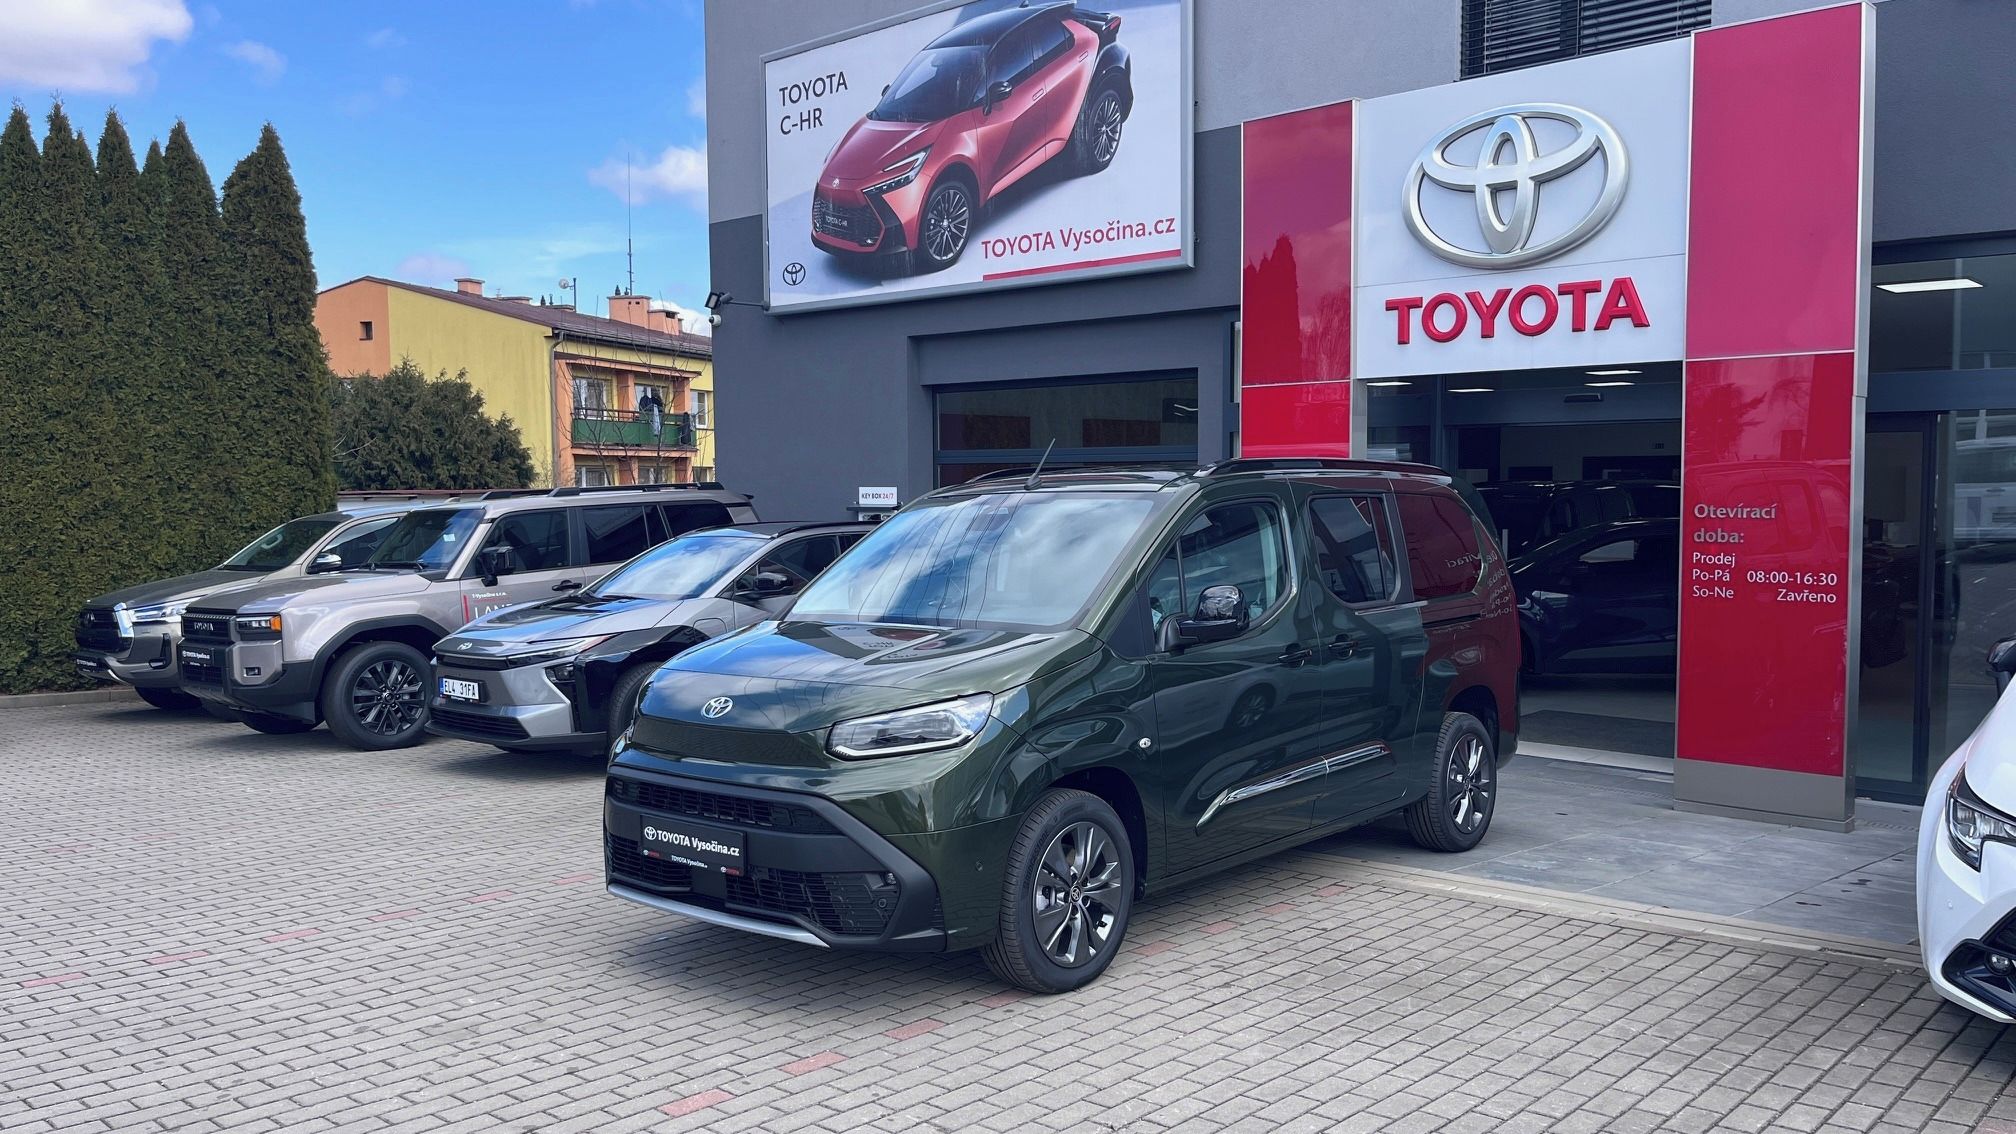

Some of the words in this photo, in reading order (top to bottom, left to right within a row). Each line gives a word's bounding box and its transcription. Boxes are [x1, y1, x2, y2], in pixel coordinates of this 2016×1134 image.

[778, 71, 848, 107] TOYOTA
[780, 107, 823, 135] C-HR
[981, 231, 1055, 259] TOYOTA
[1060, 217, 1176, 251] Vysočina.cz
[1385, 277, 1650, 345] TOYOTA
[861, 492, 871, 500] KEY
[871, 492, 882, 500] BOX
[1693, 503, 1778, 519] Otevírací
[1693, 527, 1745, 543] doba:
[1692, 552, 1736, 568] Prodej
[1692, 568, 1731, 582] Po-Pá
[1746, 570, 1838, 586] 08:00-16:30
[1692, 585, 1735, 599] So-Ne
[1776, 588, 1837, 603] Zavřeno
[444, 680, 456, 695] EL4
[460, 682, 476, 697] 31FA
[656, 829, 691, 847] TOYOTA
[691, 837, 740, 857] Vysočina.cz
